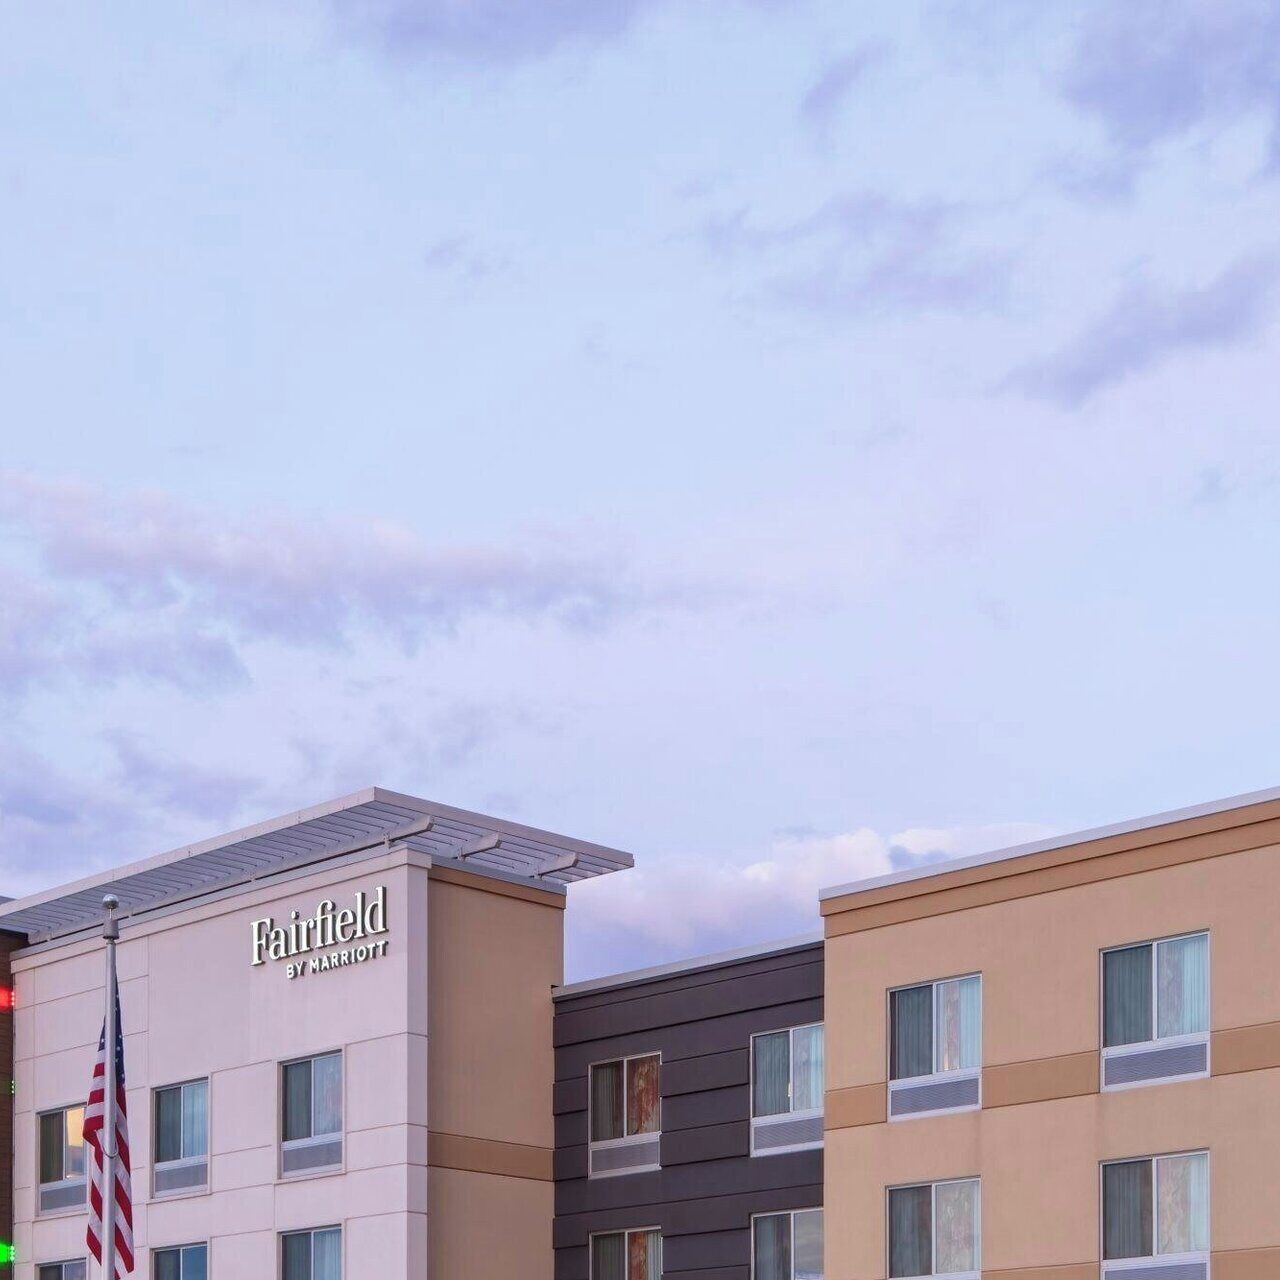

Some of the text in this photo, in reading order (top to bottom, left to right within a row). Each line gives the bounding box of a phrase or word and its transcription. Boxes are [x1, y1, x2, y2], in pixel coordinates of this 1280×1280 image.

[250, 886, 388, 966] Fairfield
[286, 940, 388, 979] BY MARRIOTT
